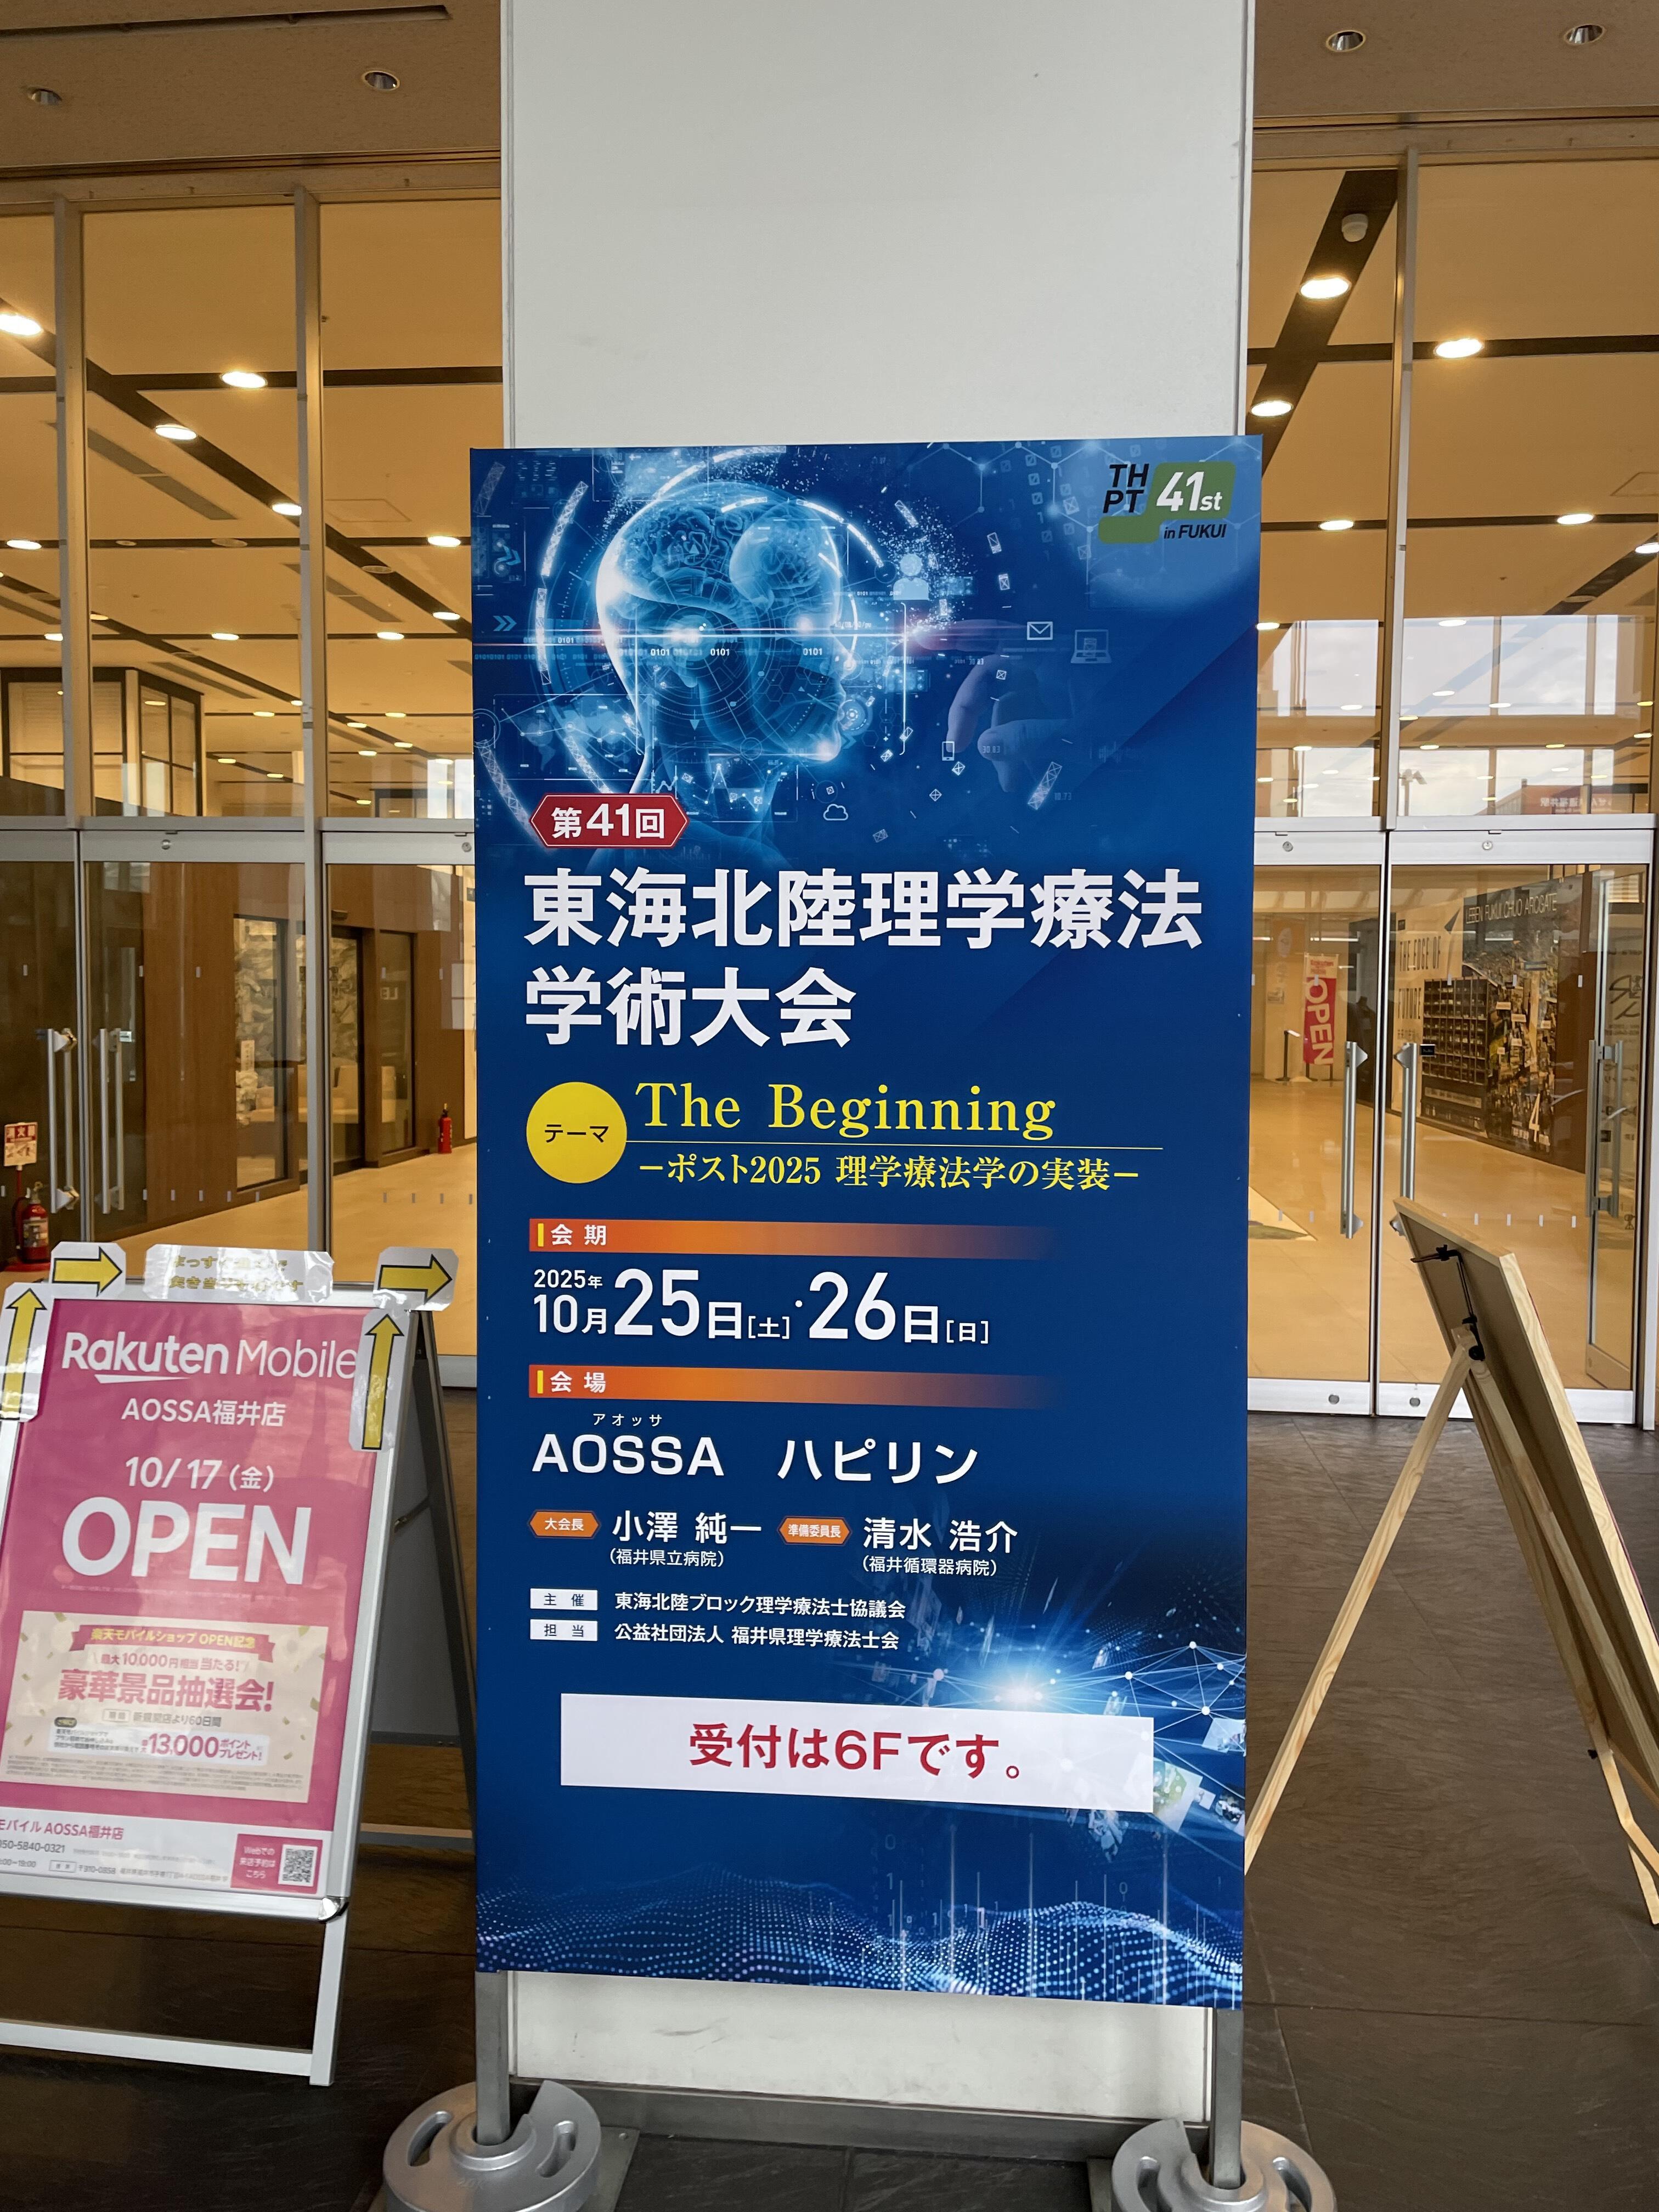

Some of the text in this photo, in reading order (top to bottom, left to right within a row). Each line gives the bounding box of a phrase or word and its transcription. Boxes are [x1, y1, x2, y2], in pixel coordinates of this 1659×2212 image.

[1109, 464, 1150, 488] TH
[1103, 489, 1144, 514] PT
[1156, 471, 1222, 512] 41st
[1164, 524, 1227, 539] in FUKUI
[551, 803, 665, 839] 第41回
[524, 867, 1203, 949] 東海北陸理学療法
[525, 966, 857, 1047] 学術大会
[1305, 978, 1334, 1065] OPEN
[635, 1082, 1056, 1141] The Beginning
[544, 1124, 609, 1143] テーマ
[550, 1224, 607, 1246] 会期
[534, 1268, 603, 1289] 2025年
[61, 1331, 357, 1379] Rakuten Mobile
[550, 1371, 606, 1394] 会場
[121, 1398, 286, 1427] AOSSA福井店
[592, 1413, 662, 1427] アオッサ
[532, 1434, 978, 1484] AOSSA ハピリン
[544, 1517, 584, 1531] 大会長
[788, 1523, 841, 1538] 準備委員長
[62, 1497, 312, 1585] OPEN
[610, 1548, 724, 1567] (福井県立病院)
[862, 1555, 997, 1577] (福井循環器病院)
[544, 1593, 584, 1607] 主催
[614, 1592, 906, 1619] 東海北陸ブロック理学療法士協議会
[544, 1623, 584, 1638] 担当
[614, 1623, 899, 1650] 公益社団法人 福井県理学療法士会
[58, 1668, 274, 1712] 豪華景品抽選会!
[149, 1733, 219, 1758] 13,000
[688, 1722, 1020, 1780] 受付は6Fです。
[44, 1822, 124, 1840] AOSSA福井店
[0, 1840, 65, 1853] 50-5840-0321
